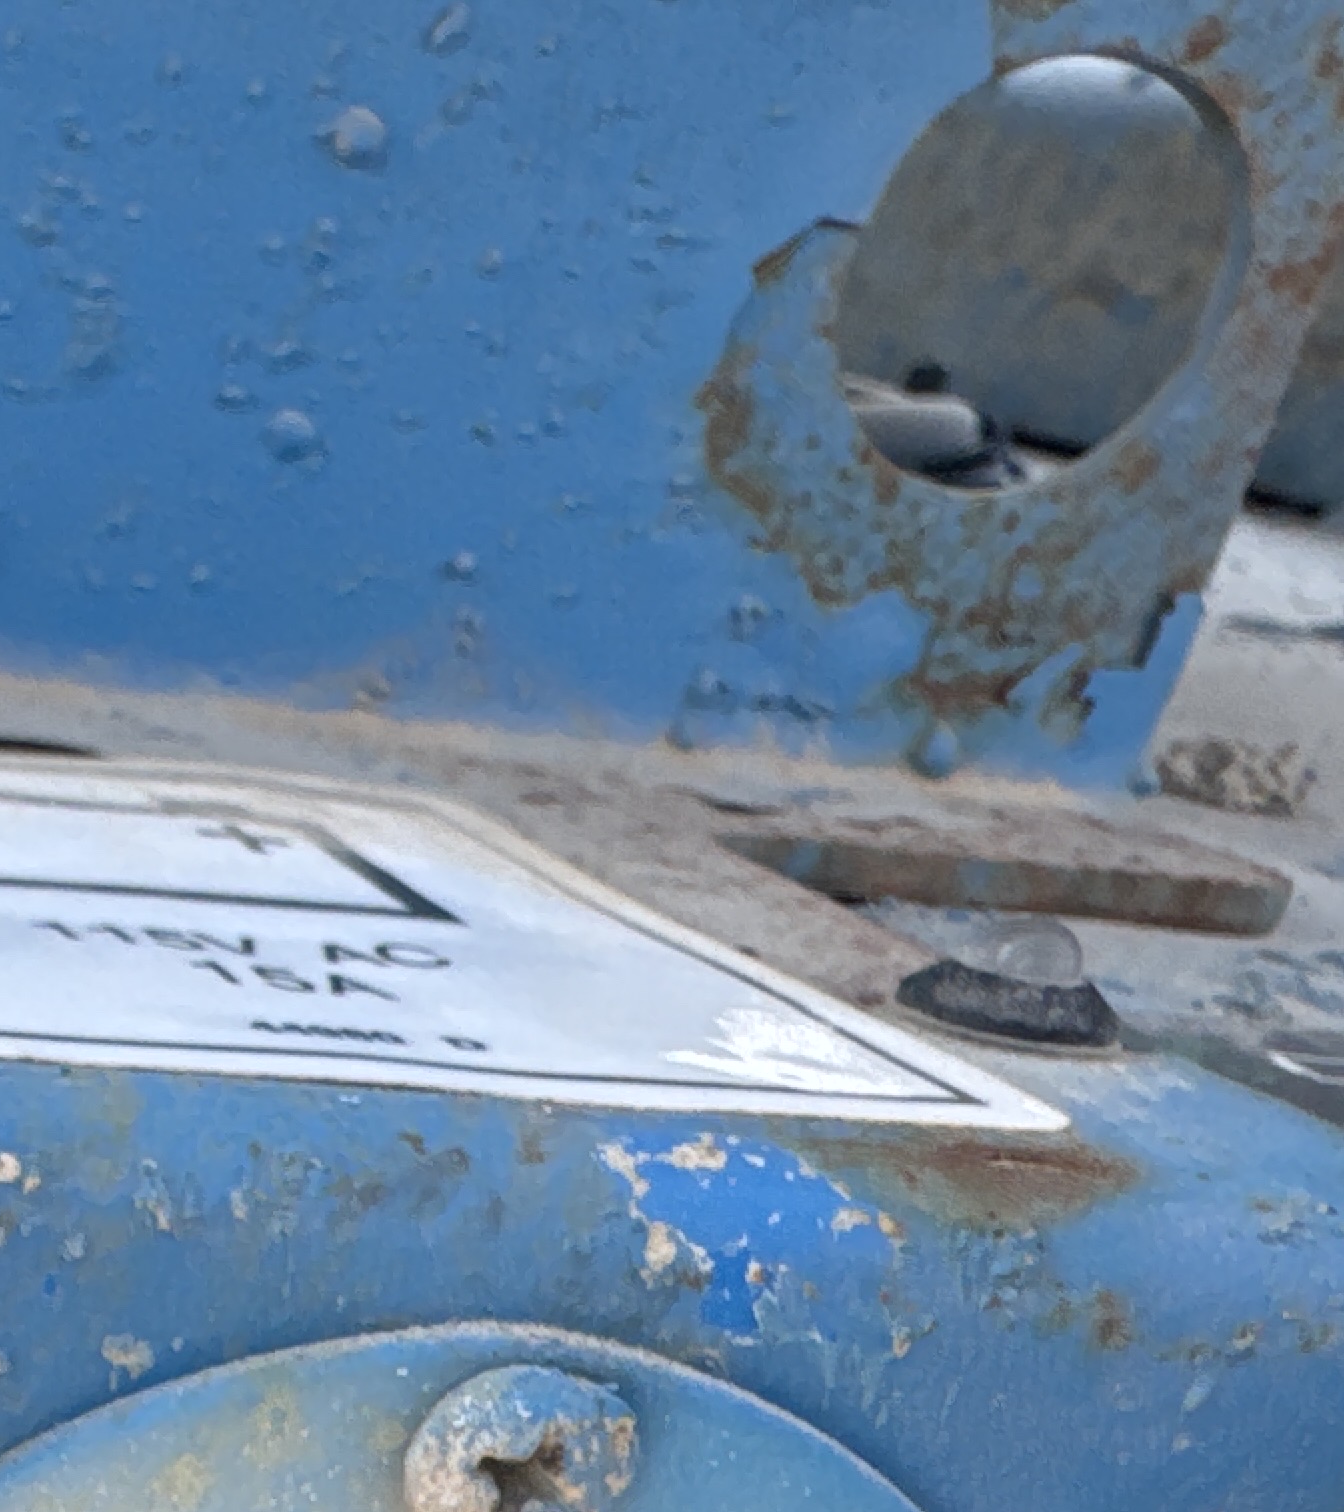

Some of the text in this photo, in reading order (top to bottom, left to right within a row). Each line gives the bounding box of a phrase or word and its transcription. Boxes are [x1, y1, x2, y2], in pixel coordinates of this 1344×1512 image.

[32, 919, 454, 969] 115V AC
[191, 958, 403, 1002] 15A
